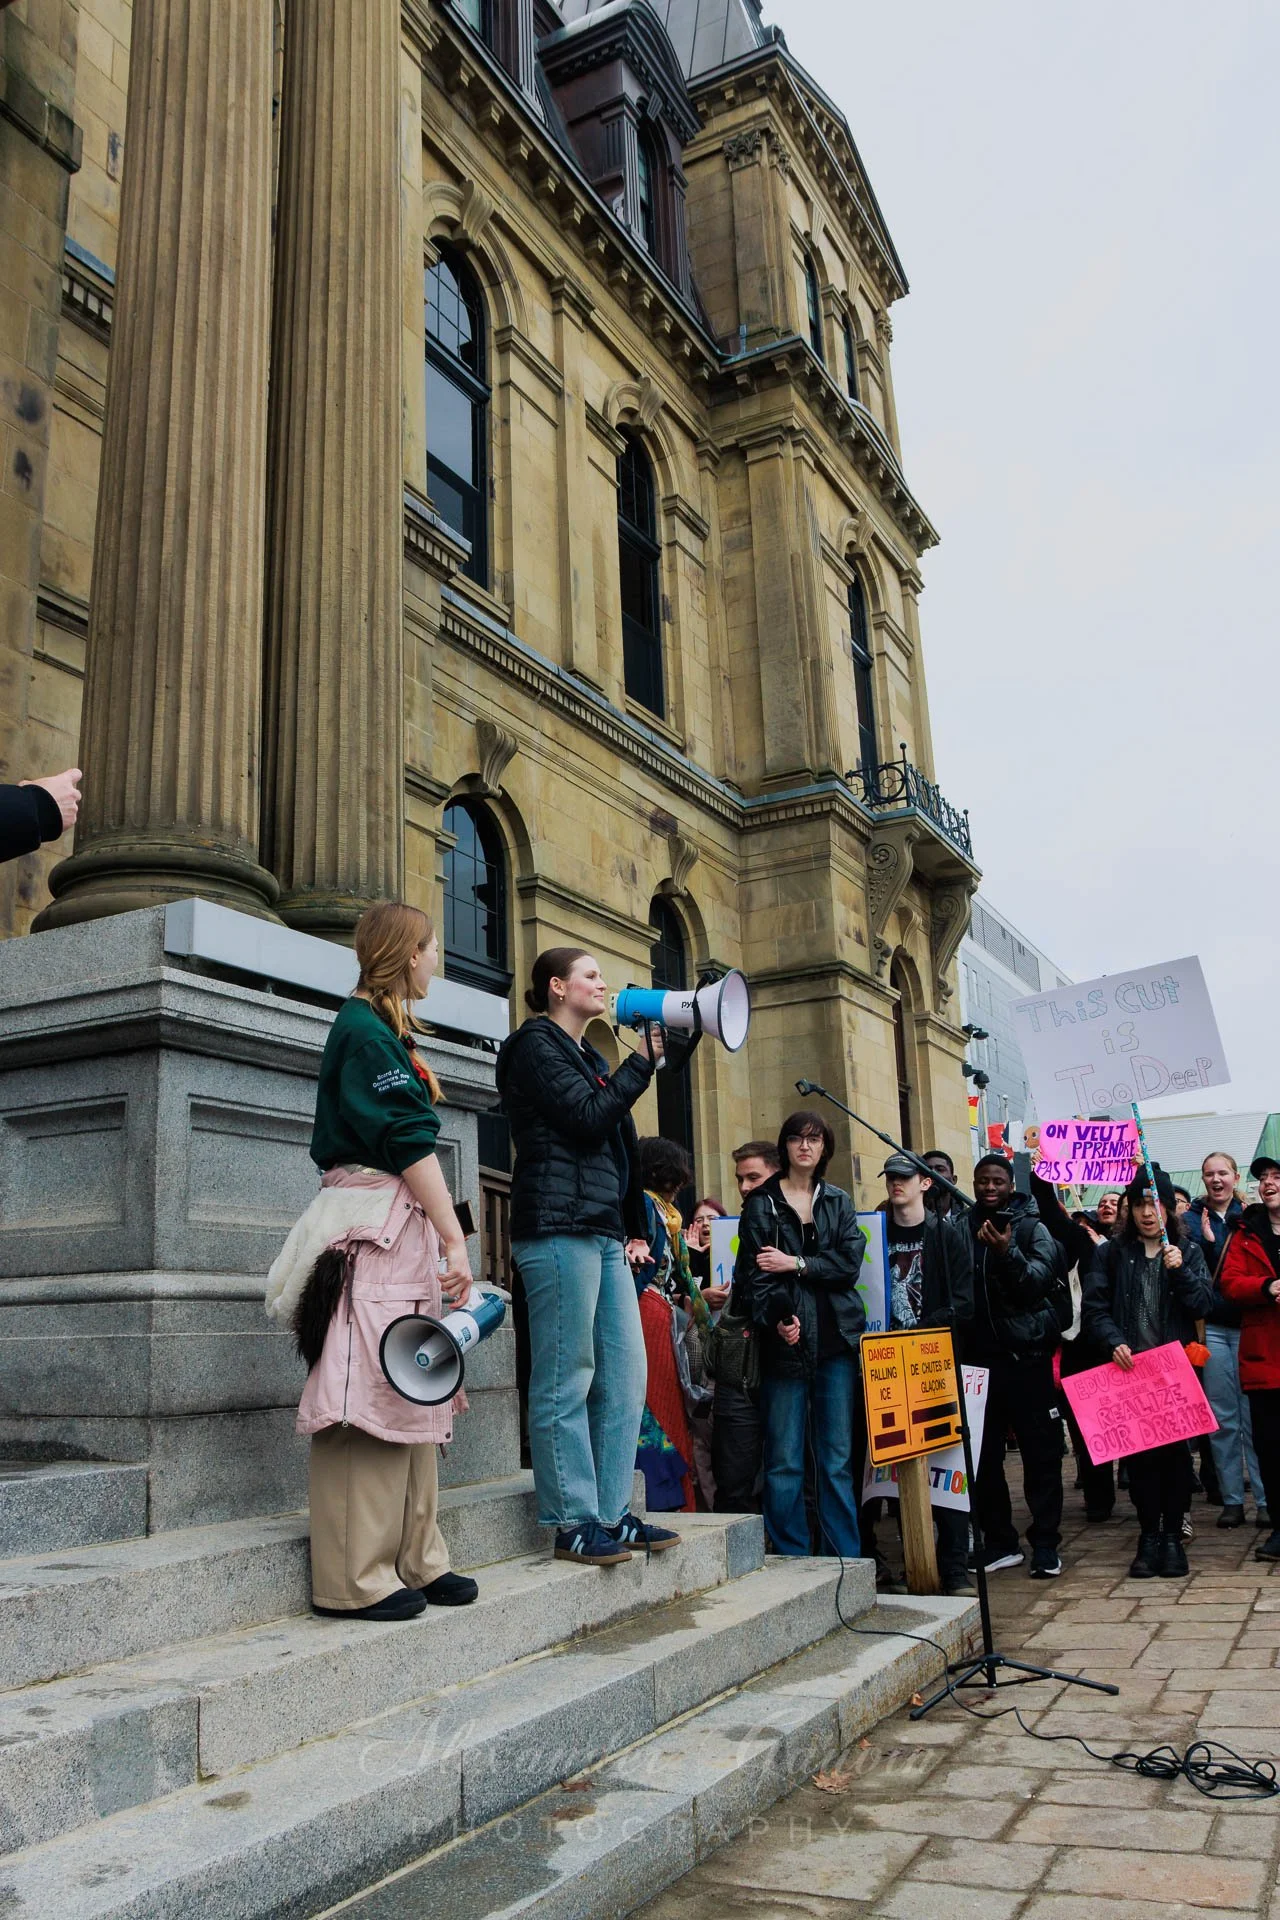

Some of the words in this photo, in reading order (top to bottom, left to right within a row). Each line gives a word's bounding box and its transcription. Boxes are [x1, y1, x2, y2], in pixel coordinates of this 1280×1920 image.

[372, 1075, 399, 1088] Governors
[377, 1071, 392, 1080] Board
[1046, 1124, 1069, 1139] ON
[1075, 1124, 1129, 1142] VEUT
[1058, 1139, 1136, 1159] APPRENDRE
[1036, 1160, 1061, 1181] PAS
[868, 1347, 896, 1361] DANGER
[920, 1342, 940, 1355] RISQUE
[870, 1366, 898, 1382] FALLING
[910, 1363, 919, 1376] DE
[921, 1360, 942, 1375] CHUTES
[943, 1359, 952, 1370] DE
[1074, 1350, 1177, 1400] EDUCATION
[880, 1387, 892, 1401] ICE
[920, 1379, 947, 1395] GLAÇONS
[1097, 1383, 1188, 1431] REALIZE
[1089, 1425, 1136, 1458] OUR
[1138, 1403, 1213, 1446] DREAMS
